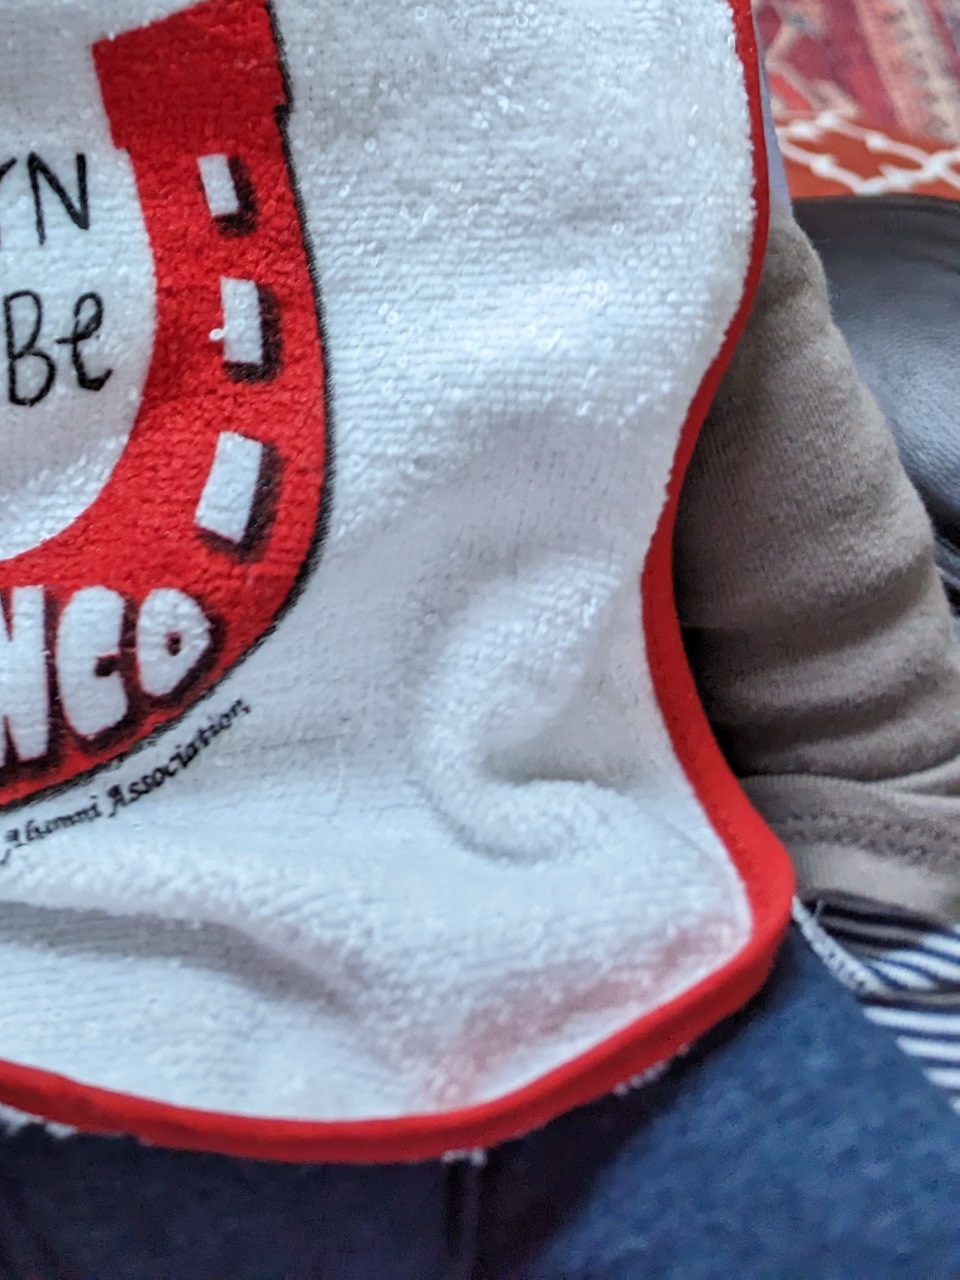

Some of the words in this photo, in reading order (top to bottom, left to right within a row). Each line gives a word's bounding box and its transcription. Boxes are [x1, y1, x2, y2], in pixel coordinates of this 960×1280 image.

[3, 289, 113, 407] Be
[0, 795, 103, 866] Alumni
[107, 699, 252, 818] Association
